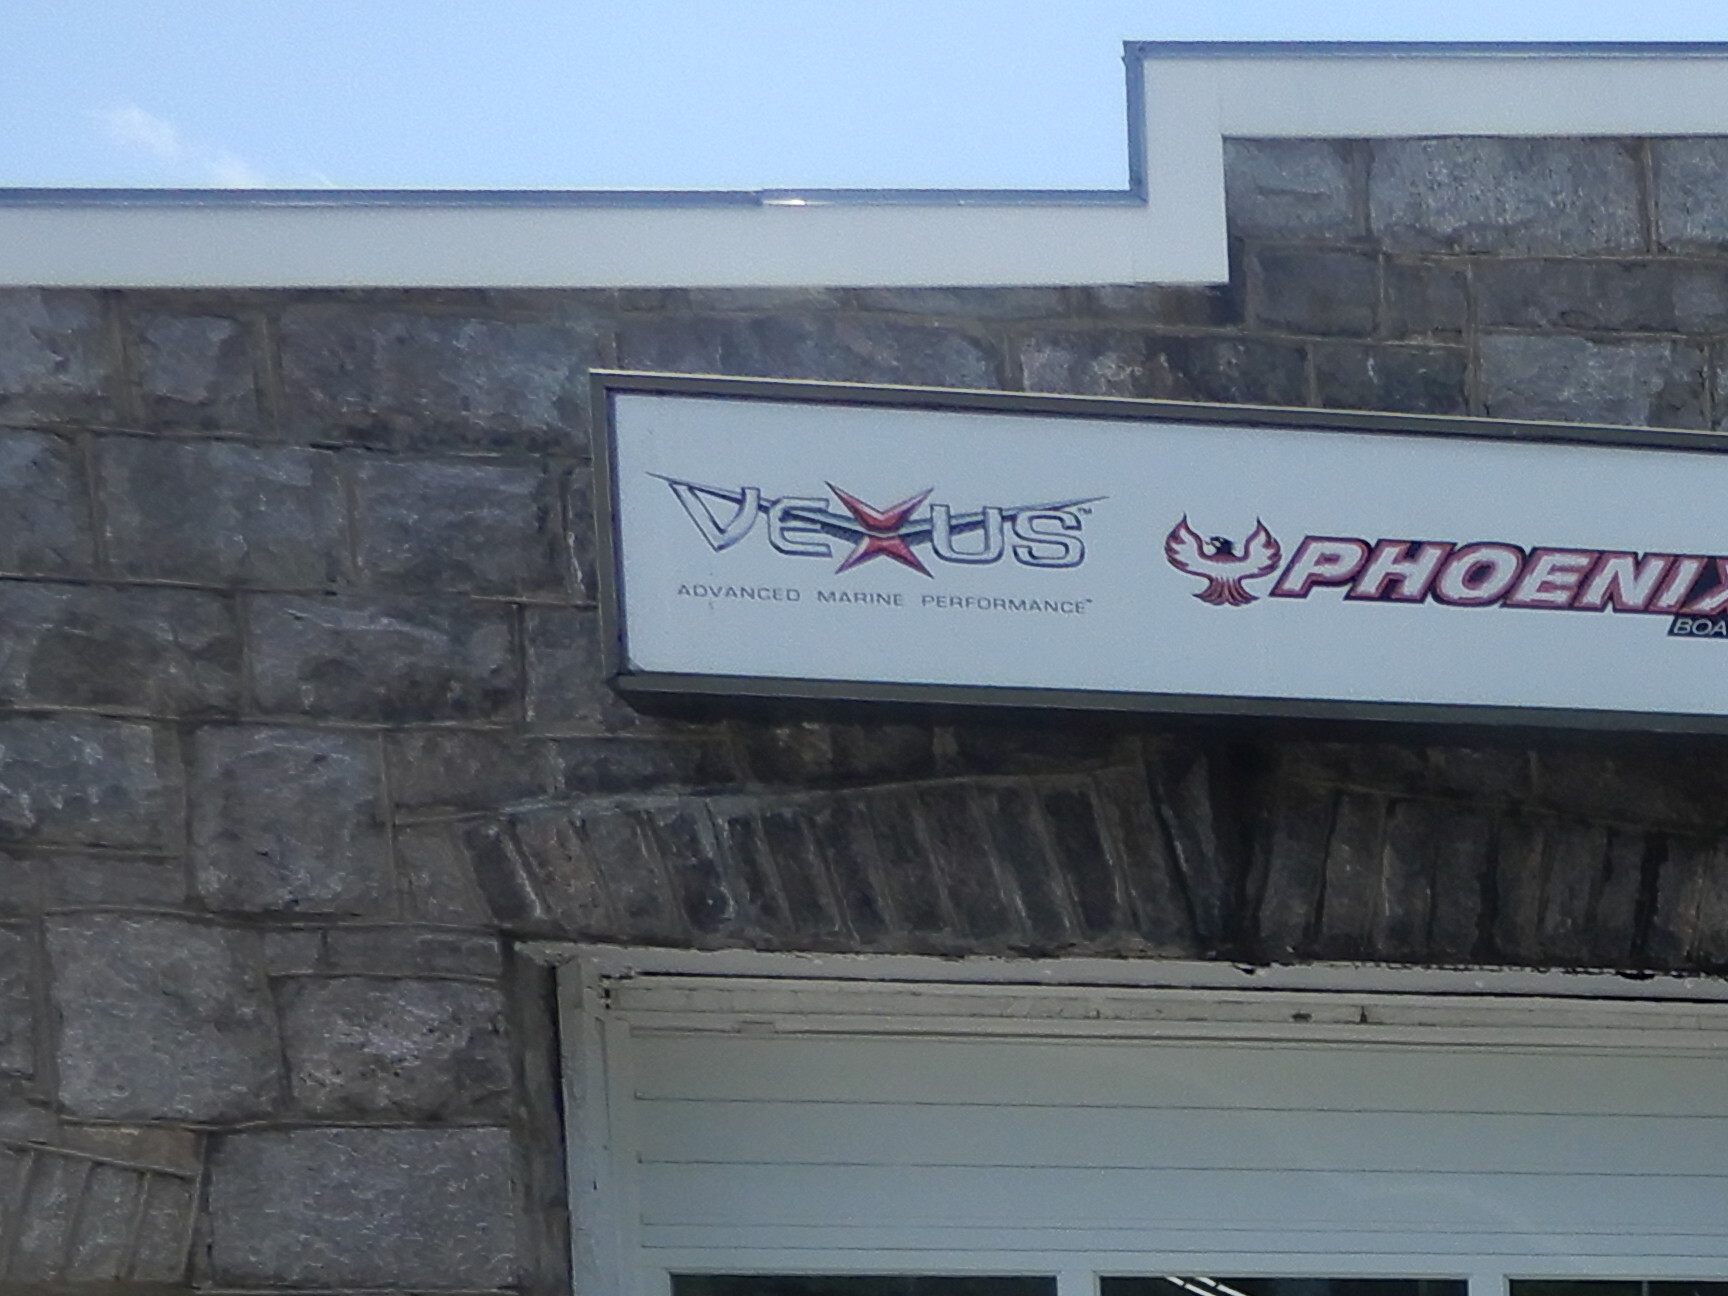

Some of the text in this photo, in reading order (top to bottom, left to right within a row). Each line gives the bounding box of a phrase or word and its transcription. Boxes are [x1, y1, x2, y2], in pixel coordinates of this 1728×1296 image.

[655, 476, 1092, 579] VEXUS
[677, 583, 1087, 615] ADVANCED MARINE PERFORMANCE
